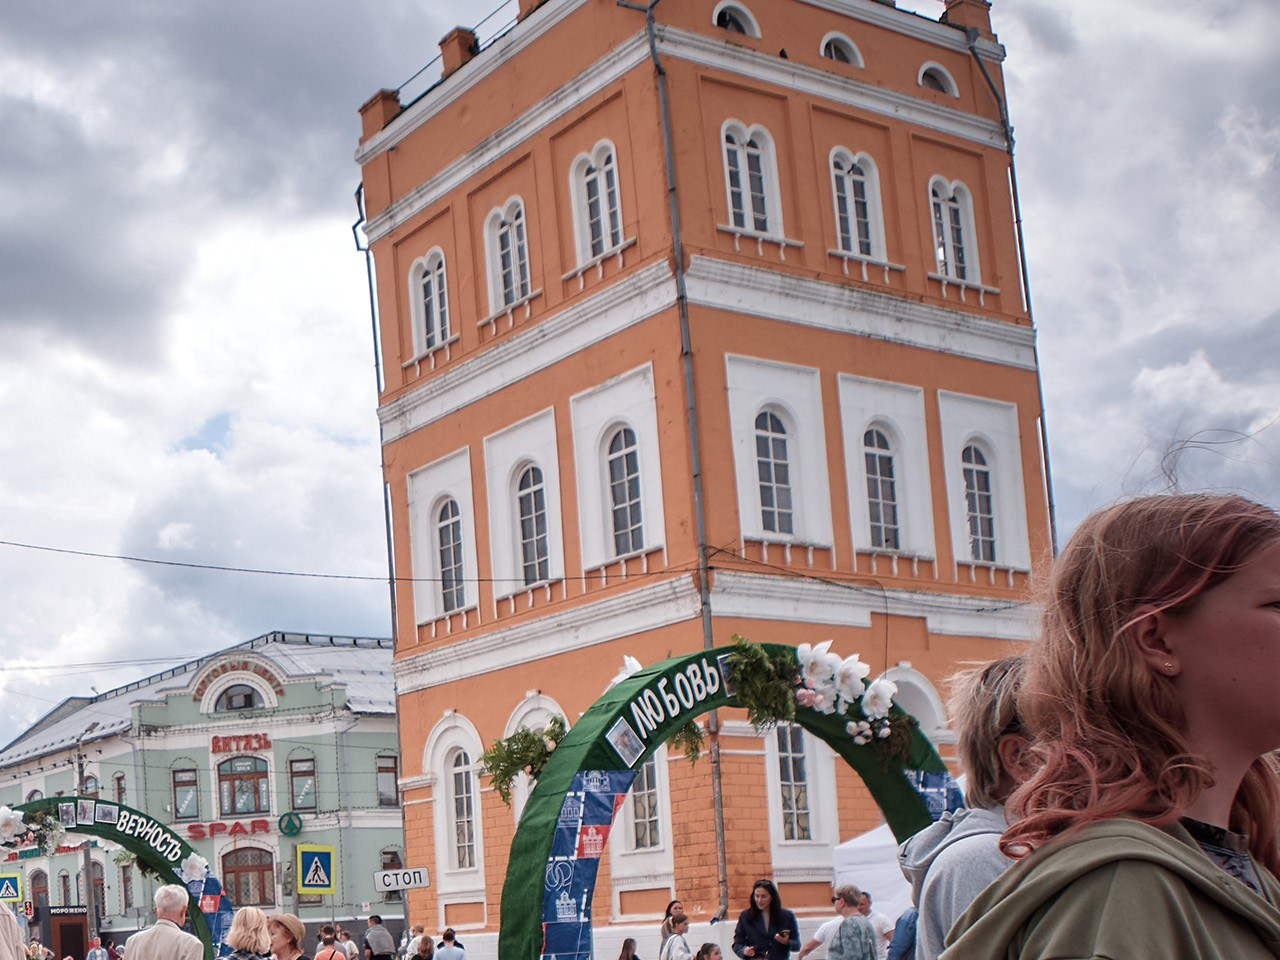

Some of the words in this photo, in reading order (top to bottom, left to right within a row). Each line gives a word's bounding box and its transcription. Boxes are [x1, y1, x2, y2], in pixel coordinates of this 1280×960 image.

[192, 660, 249, 702] ТОРГОВЫЙ
[252, 662, 285, 696] ЦЕНТР
[630, 657, 720, 739] ЛЮБОВЬ
[211, 733, 272, 754] ВИТЯЗЬ
[116, 810, 182, 862] ВЕРНОСТЬ
[187, 819, 270, 839] SPAR
[382, 870, 422, 887] СТОП
